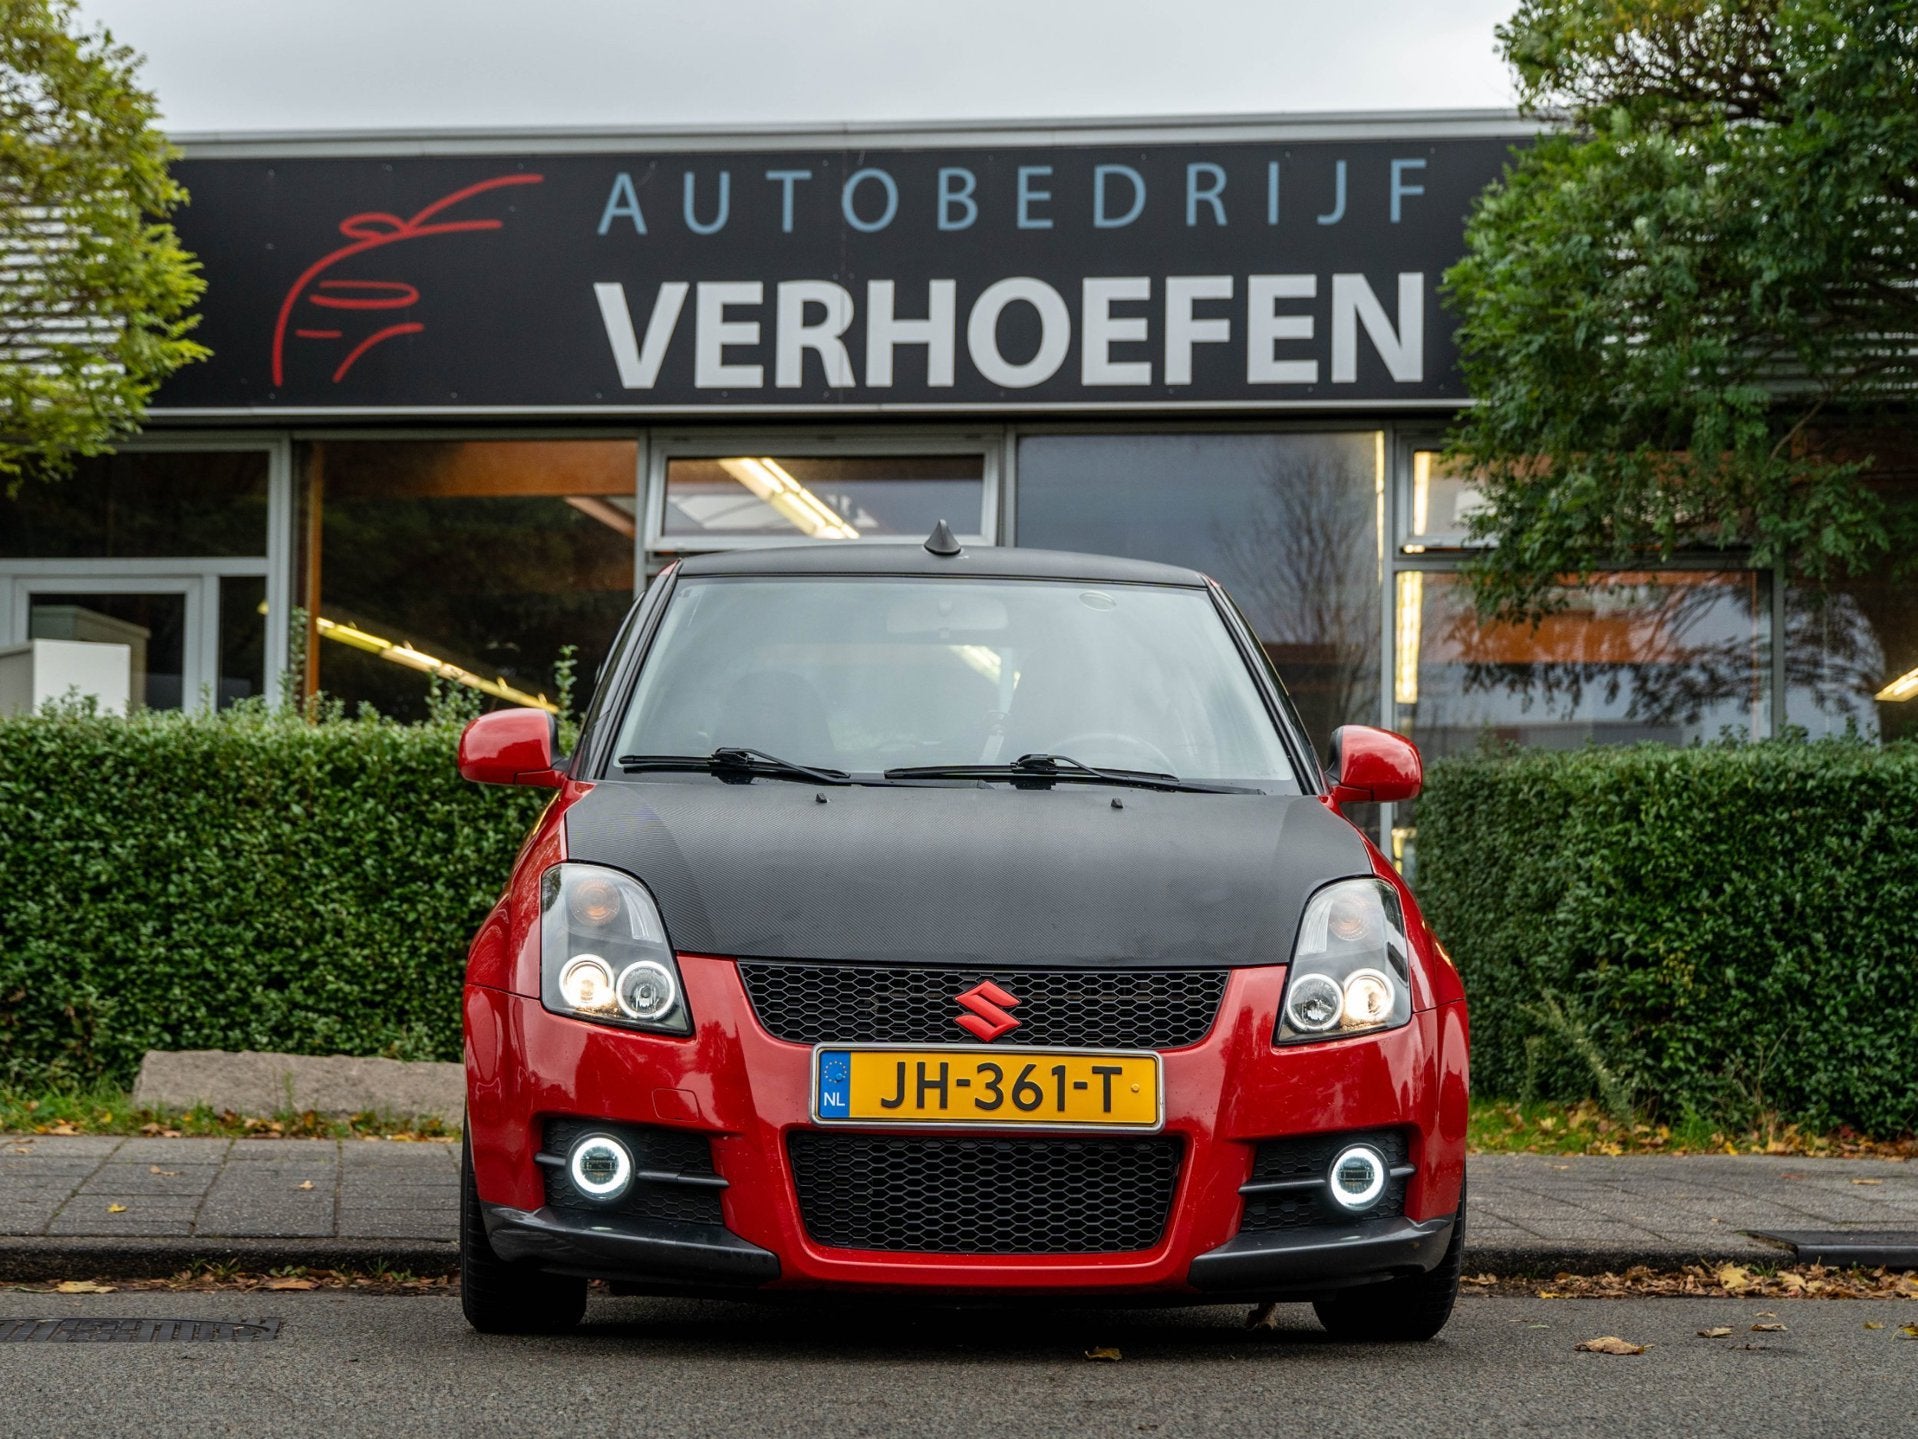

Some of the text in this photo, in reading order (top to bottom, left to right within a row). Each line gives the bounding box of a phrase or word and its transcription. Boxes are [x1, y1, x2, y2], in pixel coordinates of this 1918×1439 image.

[597, 158, 1427, 236] AUTOBEDRIJF
[593, 271, 1425, 388] VERHOEFEN
[823, 1061, 1123, 1113] NL JH-361-T
